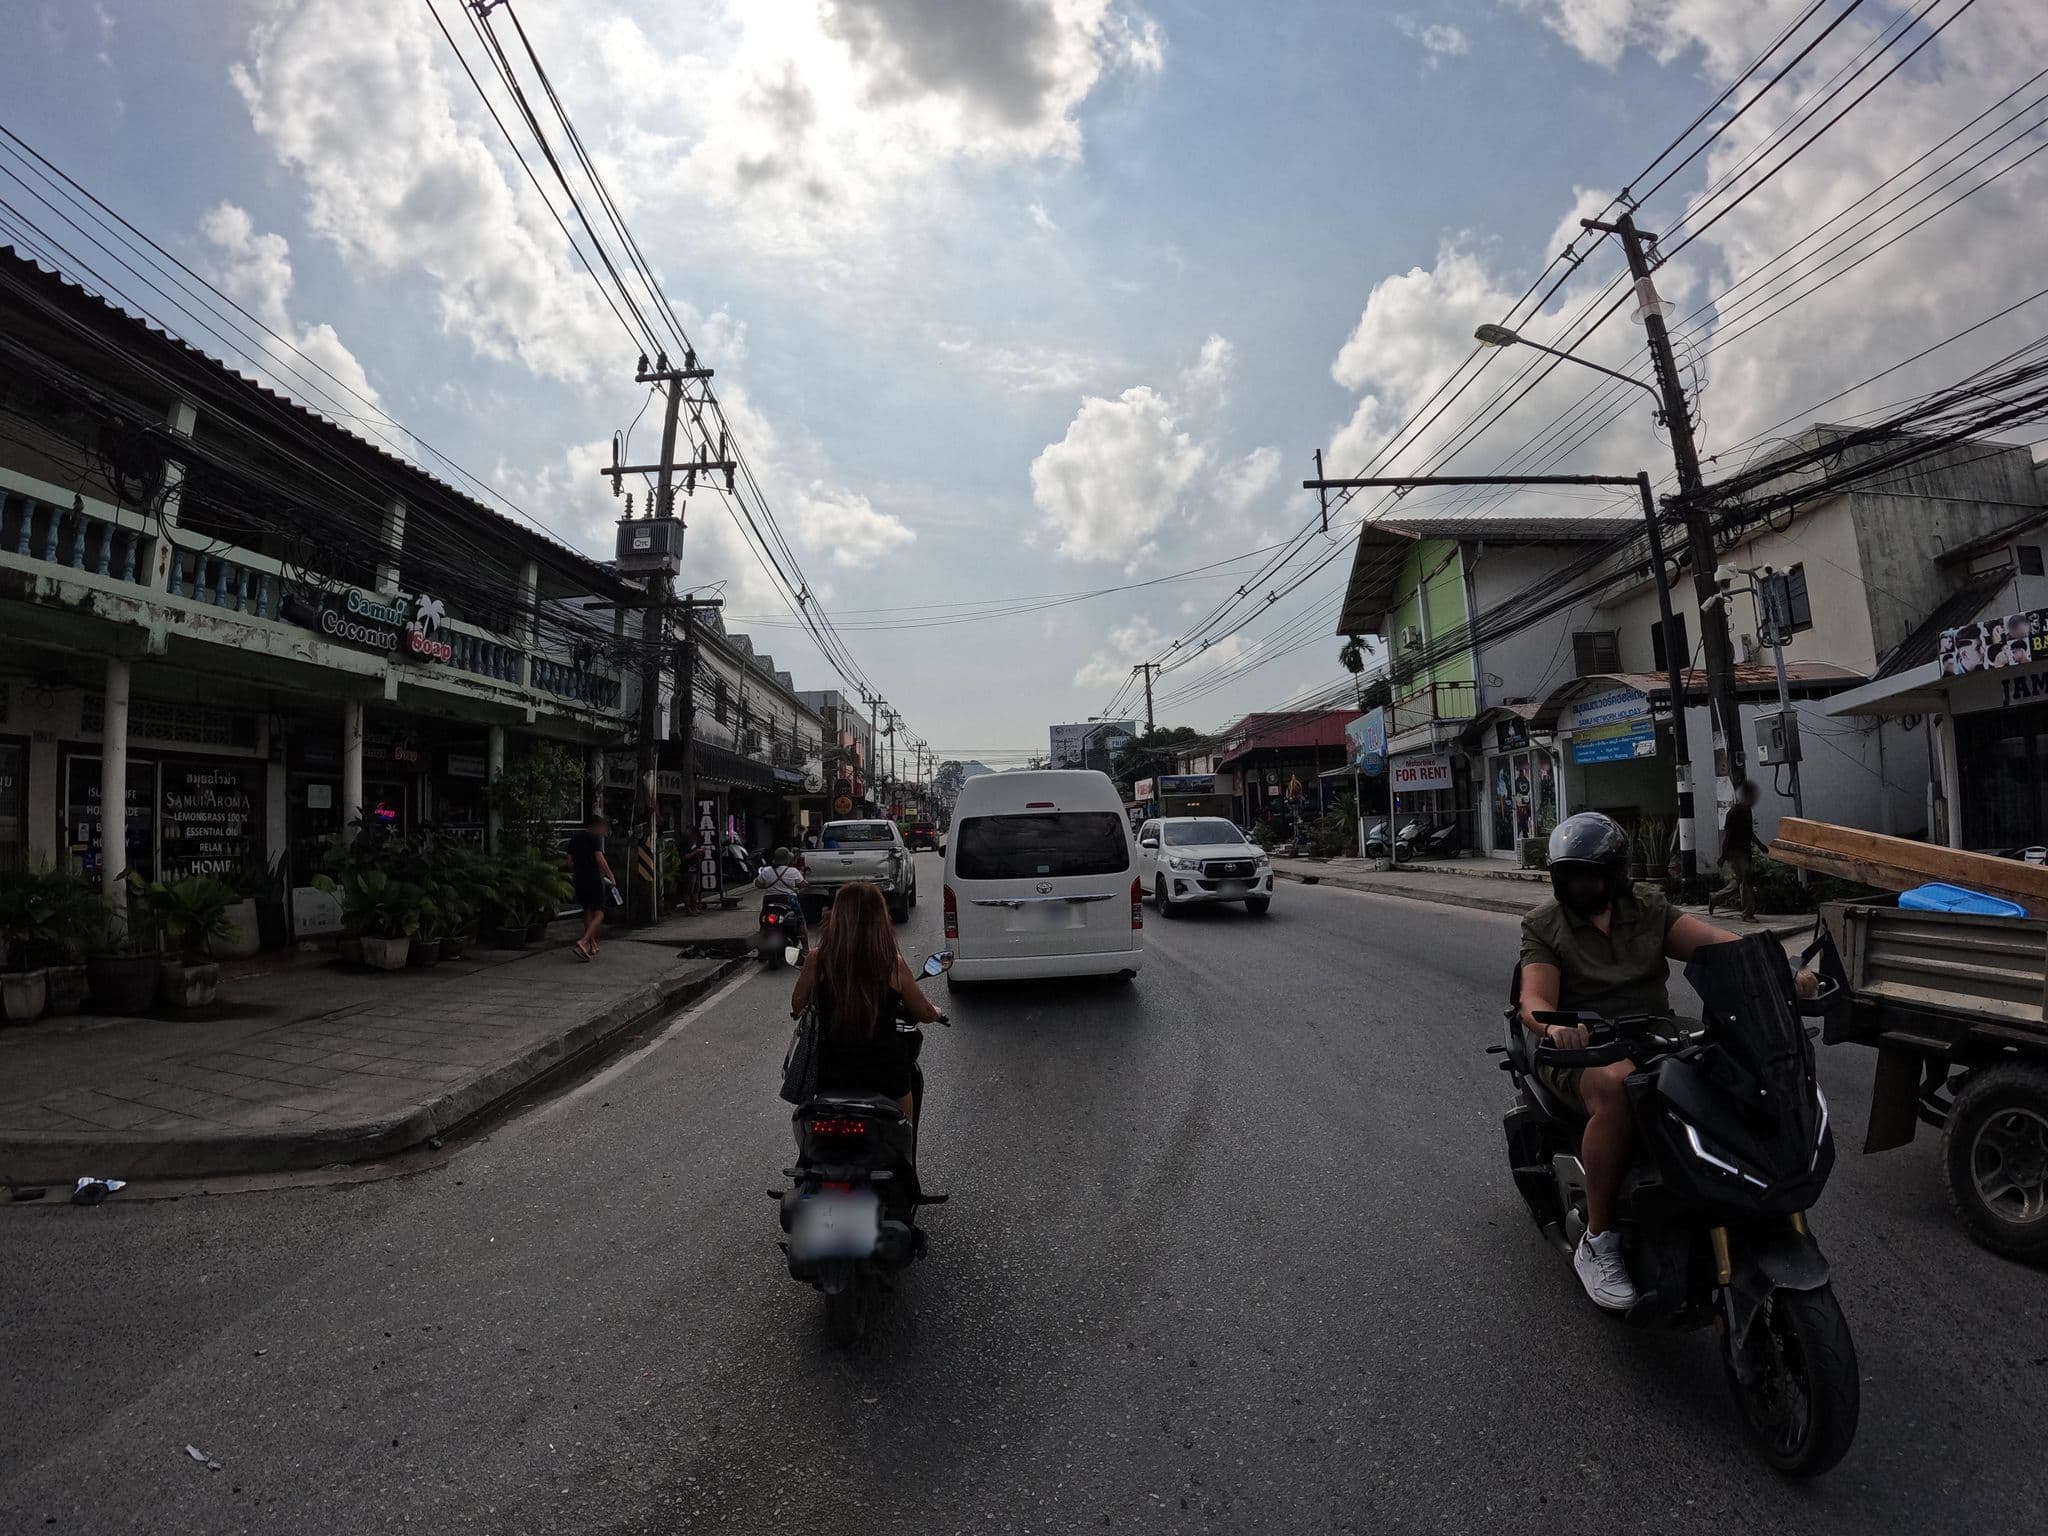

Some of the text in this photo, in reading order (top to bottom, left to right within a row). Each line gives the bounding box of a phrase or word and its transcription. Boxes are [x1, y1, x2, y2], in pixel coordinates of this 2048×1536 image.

[347, 589, 407, 626] Samui
[321, 610, 452, 663] Coconut Soap
[1618, 707, 1641, 720] HOLIDAY
[1395, 766, 1447, 782] FOR RENT
[174, 811, 226, 822] LEMONGRASS
[185, 827, 239, 837] ESSENTIAL OIL
[199, 842, 223, 853] RELAX
[698, 800, 718, 890] TATTOO
